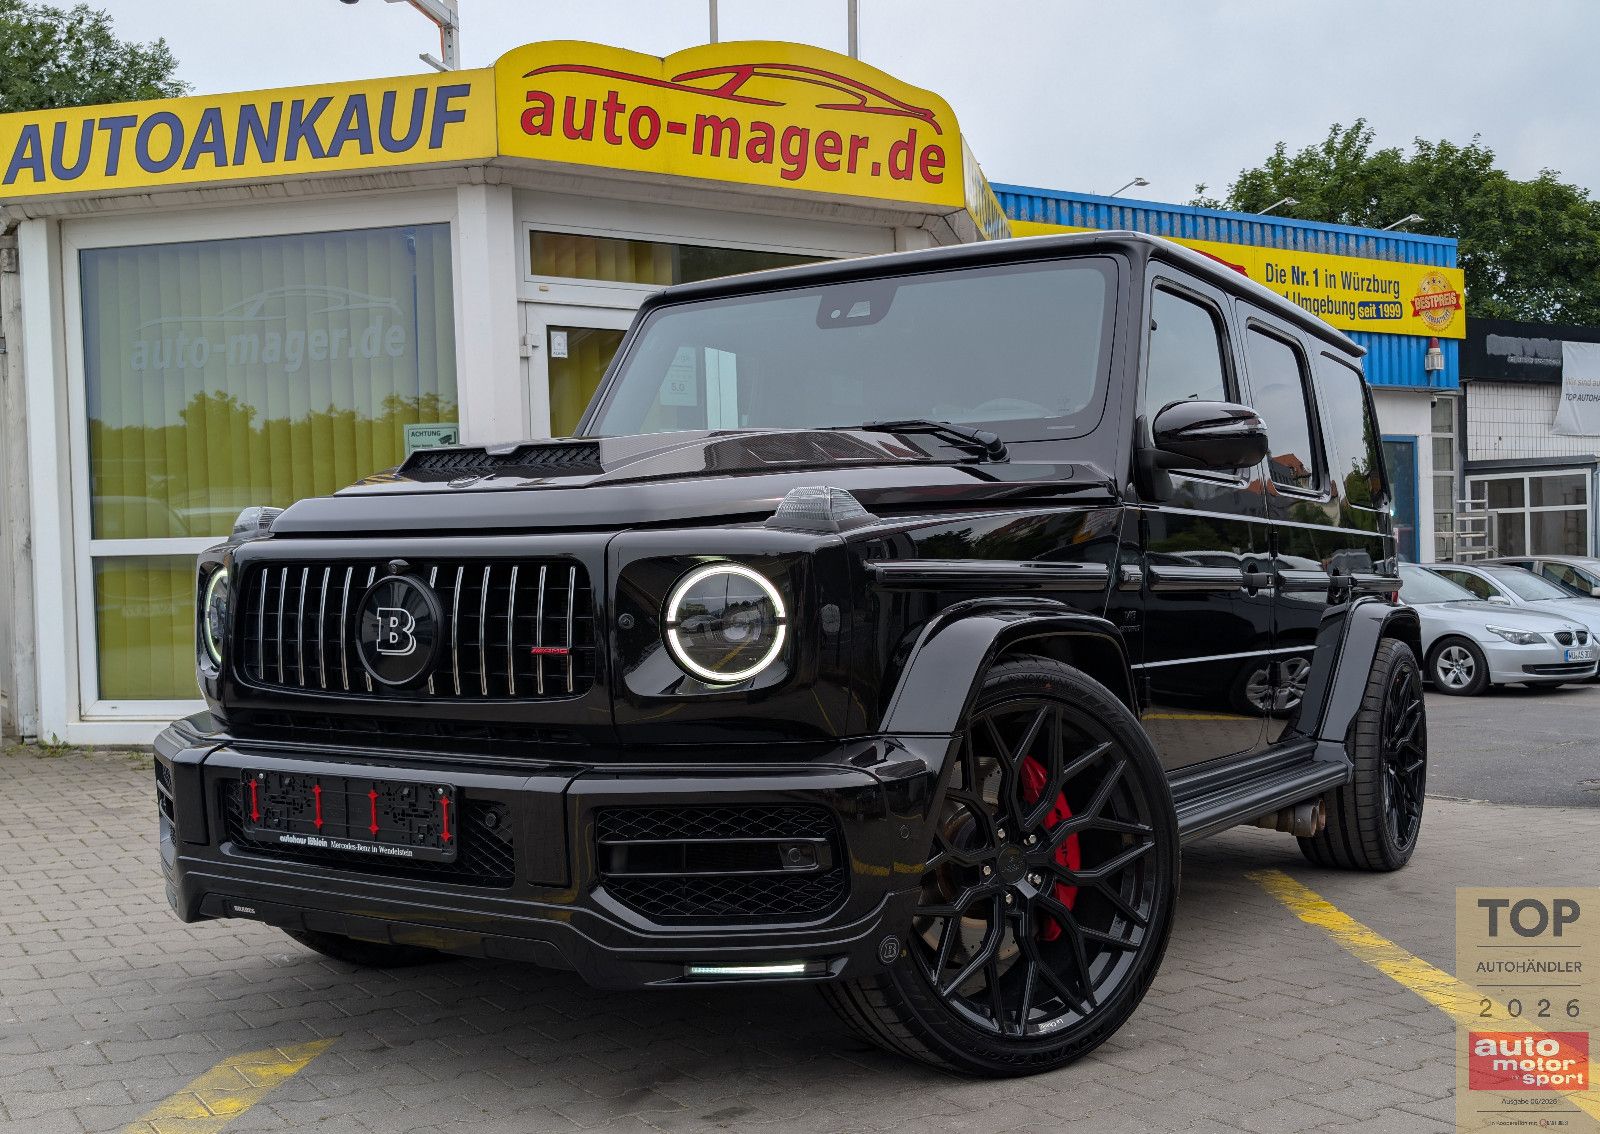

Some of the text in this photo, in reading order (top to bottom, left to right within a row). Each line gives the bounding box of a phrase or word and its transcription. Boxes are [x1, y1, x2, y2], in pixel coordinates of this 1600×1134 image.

[2, 84, 471, 185] AUTOANKAUF
[520, 90, 946, 184] auto-mager.de
[1265, 263, 1400, 299] Die Nr. 1 in Würzburg
[1358, 305, 1377, 318] seit
[1379, 304, 1401, 318] 1999
[1414, 291, 1457, 311] BESTPREIS
[130, 315, 406, 373] auto-mager.de
[1565, 393, 1577, 401] TOP
[376, 607, 417, 656] B
[330, 840, 370, 852] Mercedes-Benz
